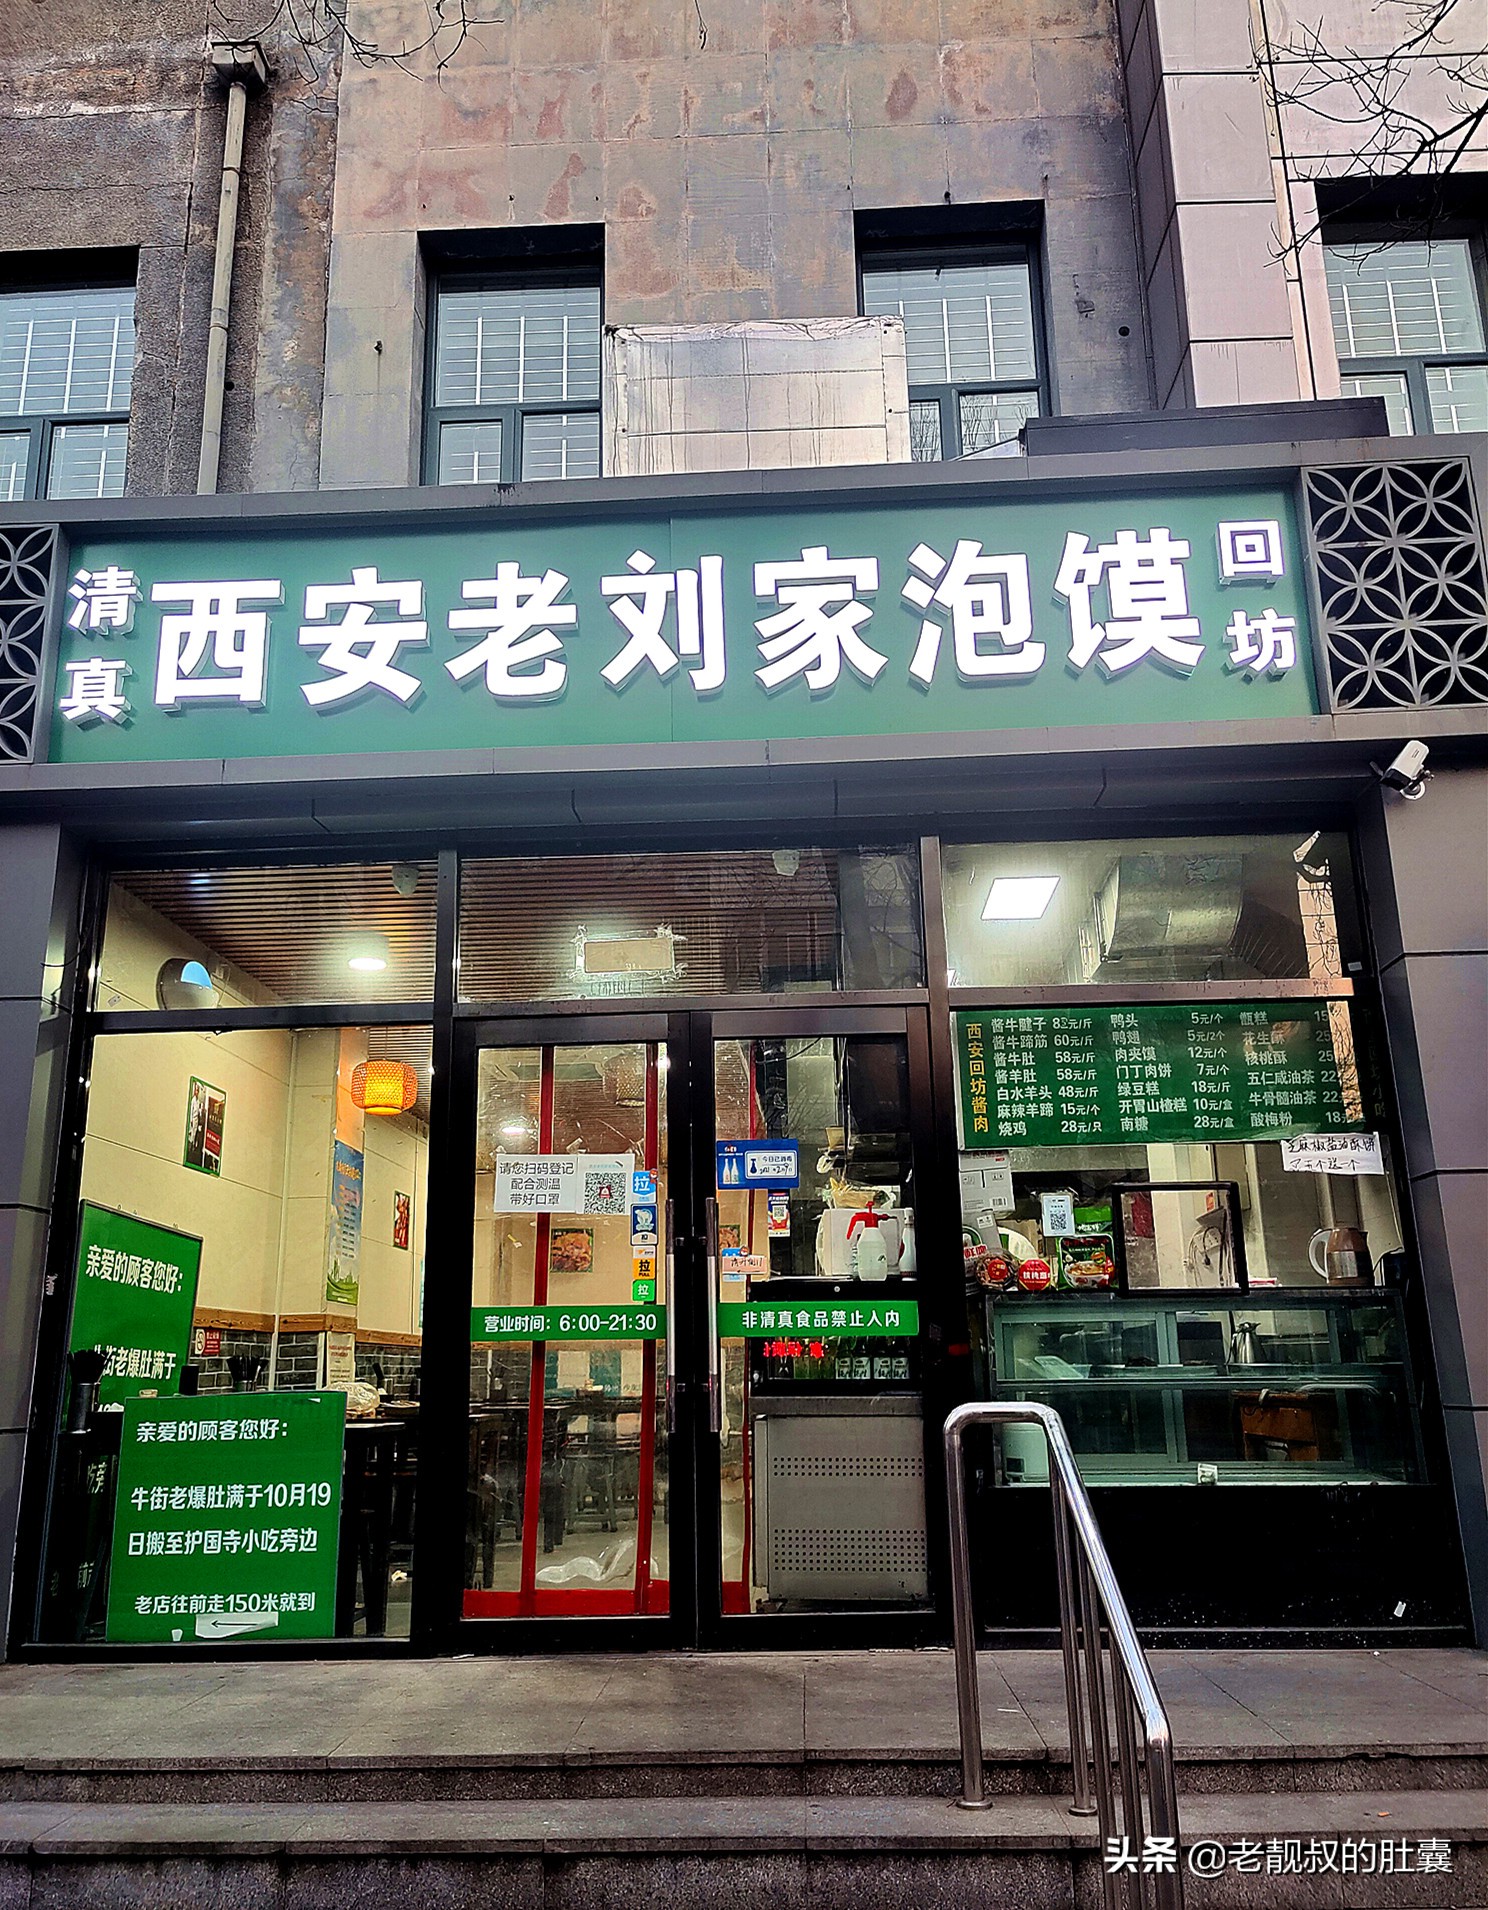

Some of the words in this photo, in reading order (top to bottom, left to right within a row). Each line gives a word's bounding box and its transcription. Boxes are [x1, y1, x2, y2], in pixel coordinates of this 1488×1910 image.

[1216, 519, 1297, 679] 回坊
[150, 526, 1206, 710] 西安老刘家泡馍
[60, 566, 141, 724] 清真
[991, 1017, 1046, 1033] 酱牛腱子
[1110, 1013, 1138, 1028] 鸭头
[1191, 1012, 1223, 1024] 5元/个
[992, 1034, 1048, 1050] 酱牛蹄筋
[1054, 1035, 1094, 1047] 60元/斤
[1187, 1030, 1225, 1042] 5元/2个
[993, 1052, 1035, 1067] 酱牛肚
[1055, 1051, 1096, 1063] 58元/斤
[1115, 1046, 1156, 1062] 肉夹馍
[1188, 1046, 1227, 1059] 12元/个
[1245, 1051, 1288, 1066] 核桃酥
[966, 1023, 989, 1133] 西安回坊酱肉
[995, 1069, 1037, 1084] 酱羊肚
[1057, 1069, 1097, 1080] 58元/斤
[1116, 1063, 1172, 1079] 门丁肉饼
[1197, 1064, 1229, 1076] 7元/个
[1247, 1070, 1315, 1086] 五仁咸油茶
[997, 1085, 1052, 1101] 白水羊头
[1058, 1086, 1099, 1098] 48元/斤
[1117, 1081, 1160, 1096] 绿豆糕
[1191, 1081, 1231, 1093] 18元/斤
[1119, 1097, 1187, 1114] 开胃山楂糕
[1193, 1098, 1233, 1111] 10元/盒
[1249, 1090, 1317, 1106] 牛骨髓油茶
[997, 1102, 1054, 1119] 麻辣羊蹄
[1061, 1103, 1100, 1116] 15元/个
[1120, 1116, 1148, 1131] 南糖
[1194, 1116, 1234, 1128] 28元/盒
[1251, 1111, 1293, 1127] 酸梅粉
[998, 1121, 1027, 1136] 烧鸡
[1061, 1121, 1102, 1133] 28元/只
[500, 1162, 574, 1175] 请您扫码登记
[510, 1178, 560, 1191] 配合测温
[634, 1176, 651, 1192] 拉
[509, 1193, 560, 1206] 带好口罩
[639, 1260, 650, 1272] 拉
[638, 1284, 649, 1295] 拉
[742, 1310, 900, 1328] 非清真食品禁止入内
[130, 1483, 332, 1512] 牛街老爆肚满于10月19
[128, 1528, 318, 1556] 日搬至护国寺小吃旁边
[134, 1593, 316, 1614] 老店往前走150米就到
